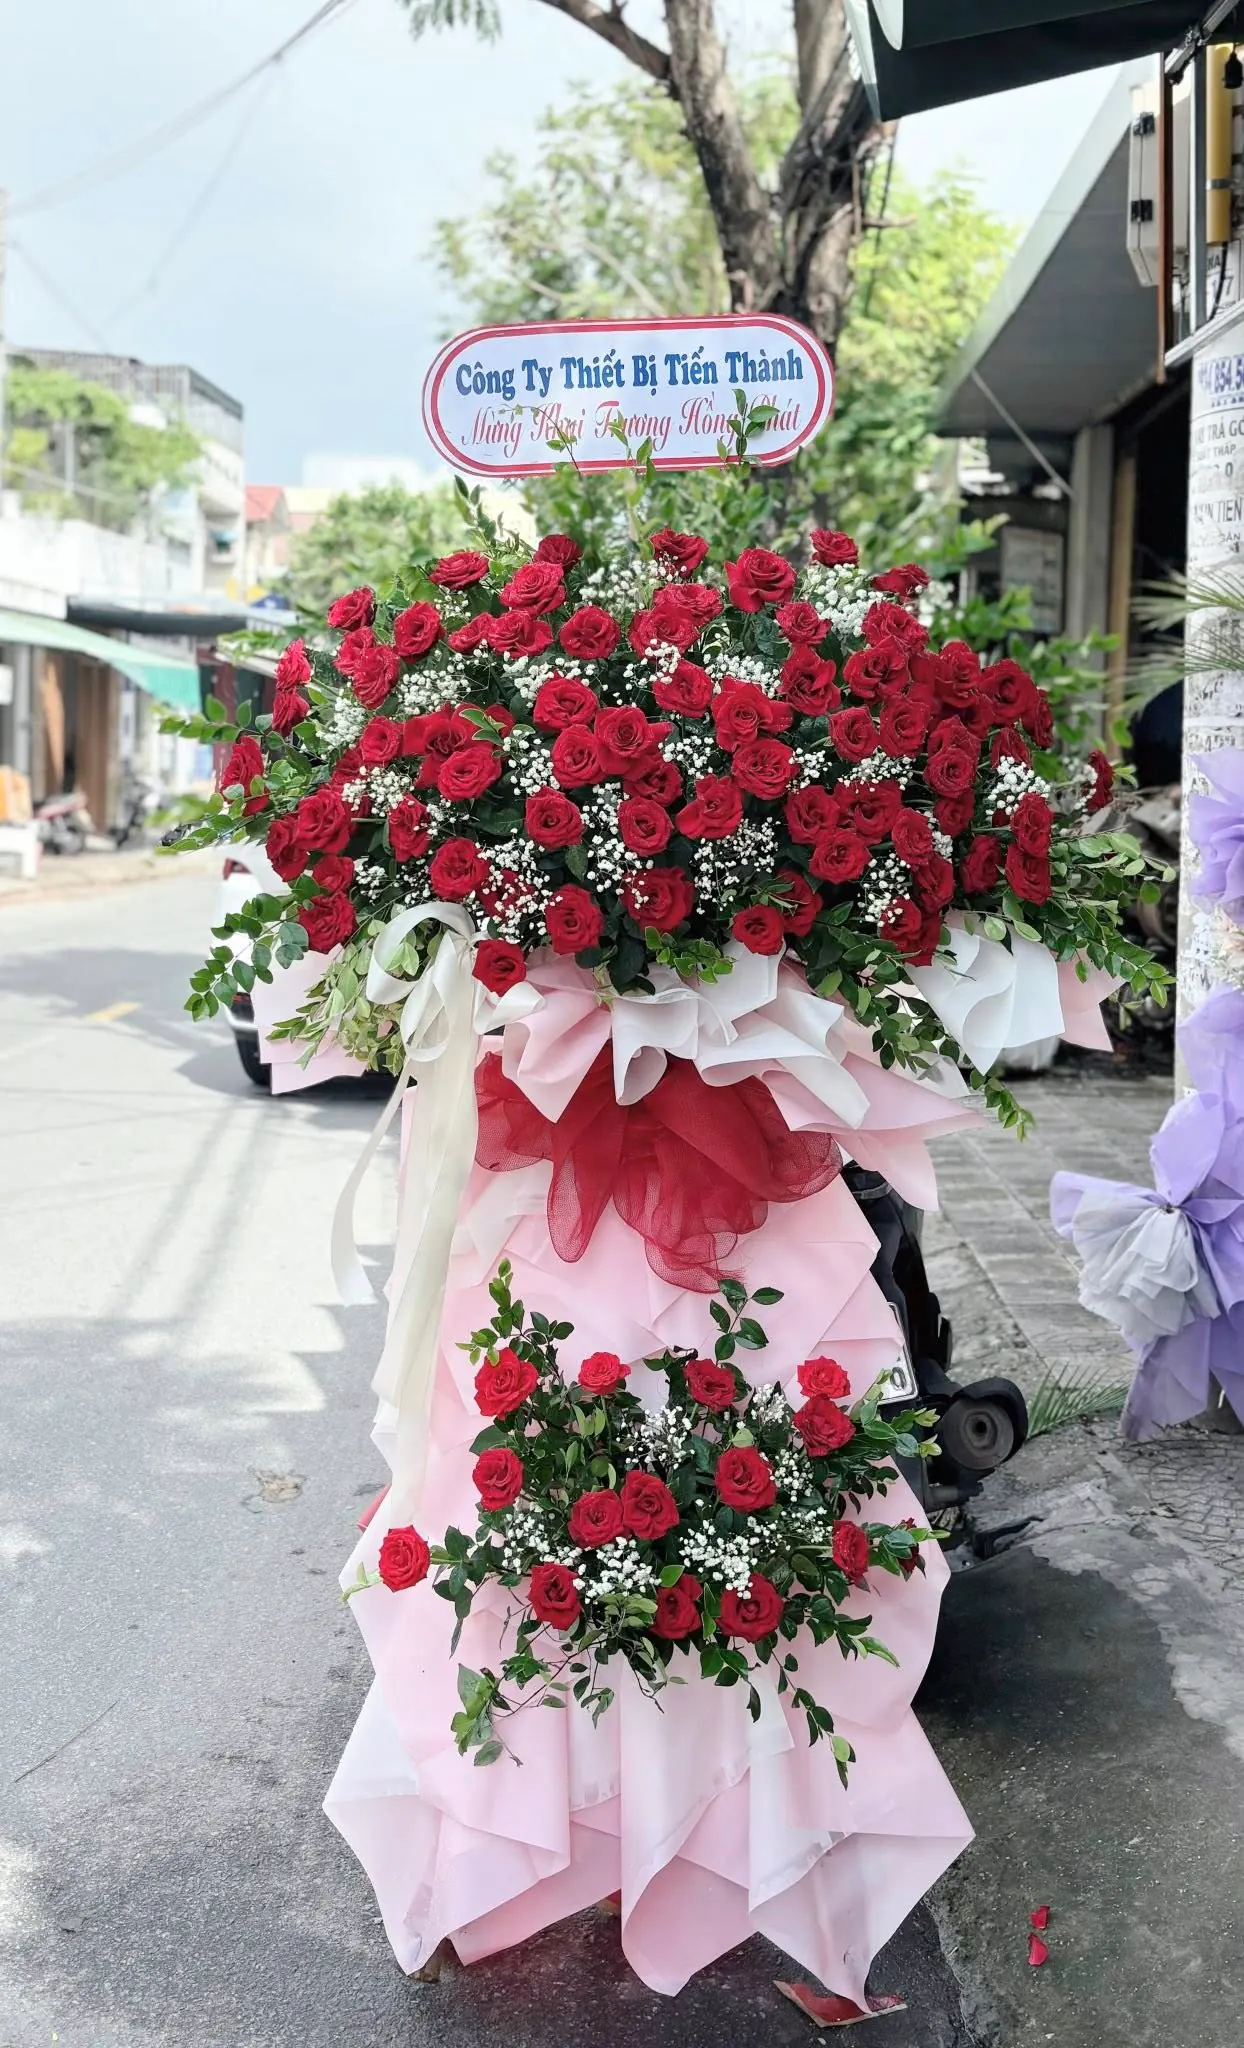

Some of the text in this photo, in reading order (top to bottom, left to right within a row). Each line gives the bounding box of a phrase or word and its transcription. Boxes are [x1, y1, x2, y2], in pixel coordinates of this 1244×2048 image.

[456, 345, 803, 401] Công Ty Thiết Bị Tiến Thành
[461, 406, 522, 458] Mừng
